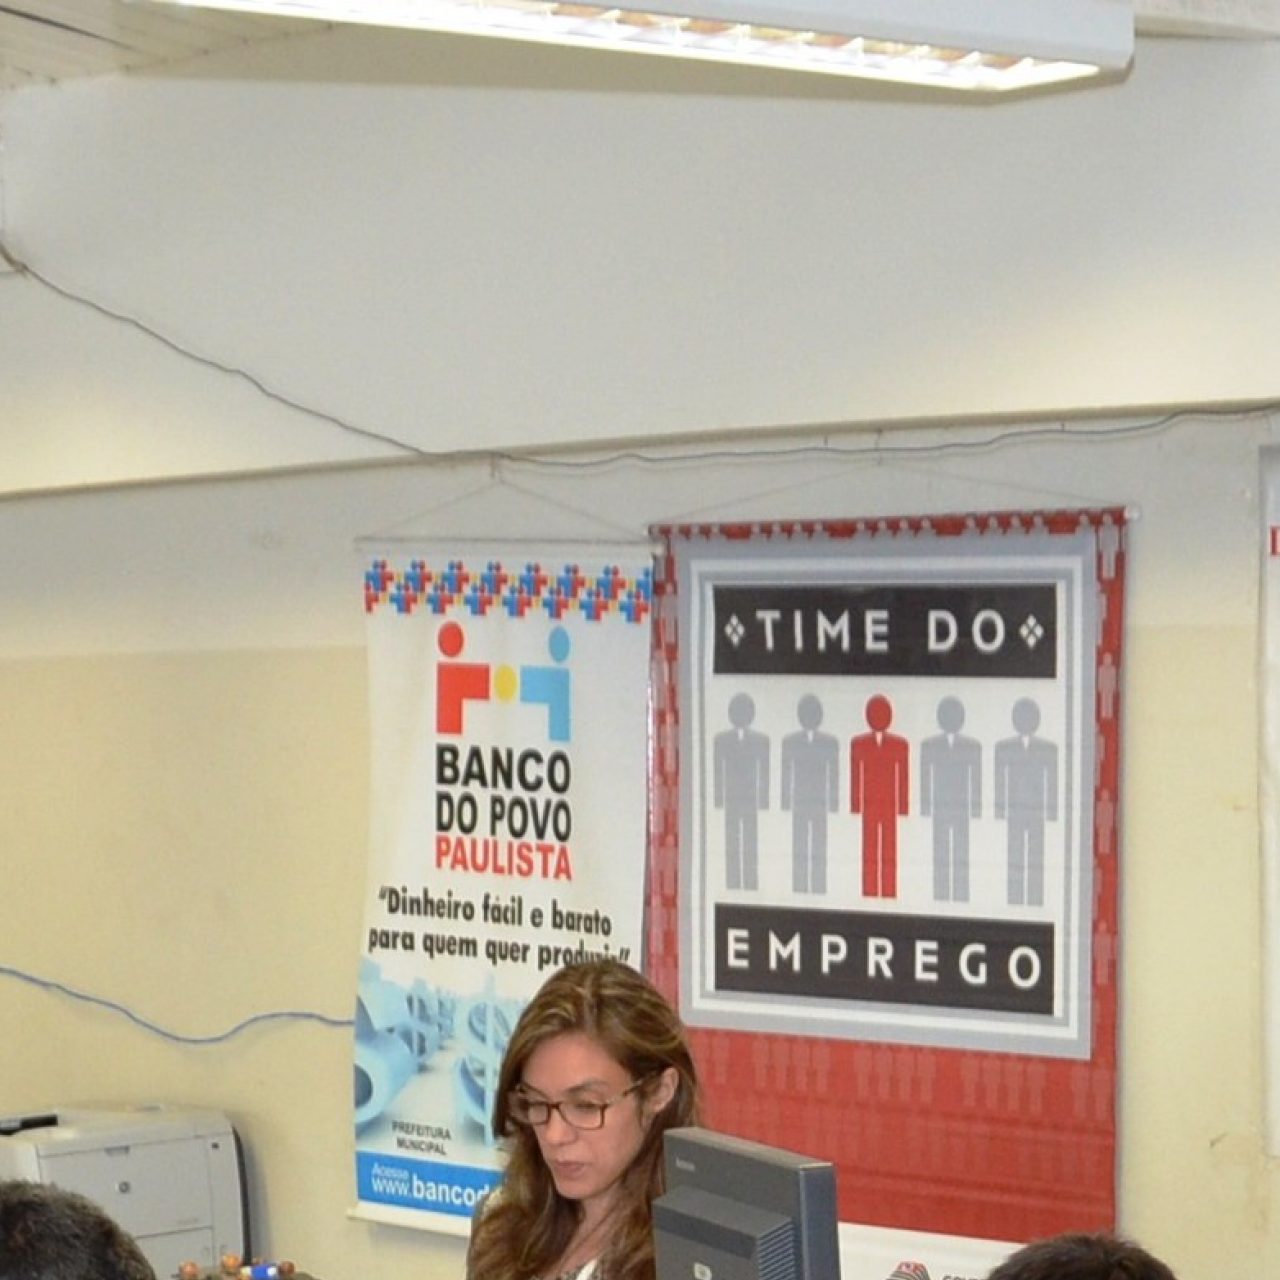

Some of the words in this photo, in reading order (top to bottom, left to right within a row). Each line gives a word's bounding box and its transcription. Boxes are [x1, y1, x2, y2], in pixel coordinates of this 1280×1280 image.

[756, 610, 889, 651] TIME
[928, 610, 1005, 653] DO
[435, 743, 570, 793] BANCO
[435, 791, 477, 834] DO
[489, 795, 570, 842] POVO
[435, 835, 572, 880] PAULISTA
[482, 892, 523, 927] fácil
[530, 906, 544, 928] e
[551, 899, 611, 936] barato
[368, 928, 415, 953] para
[422, 932, 478, 959] quem
[485, 938, 530, 967] quer
[727, 928, 1041, 989] EMPREGO
[392, 1120, 452, 1141] PREFEITURA
[396, 1137, 447, 1156] MUNICIPAL
